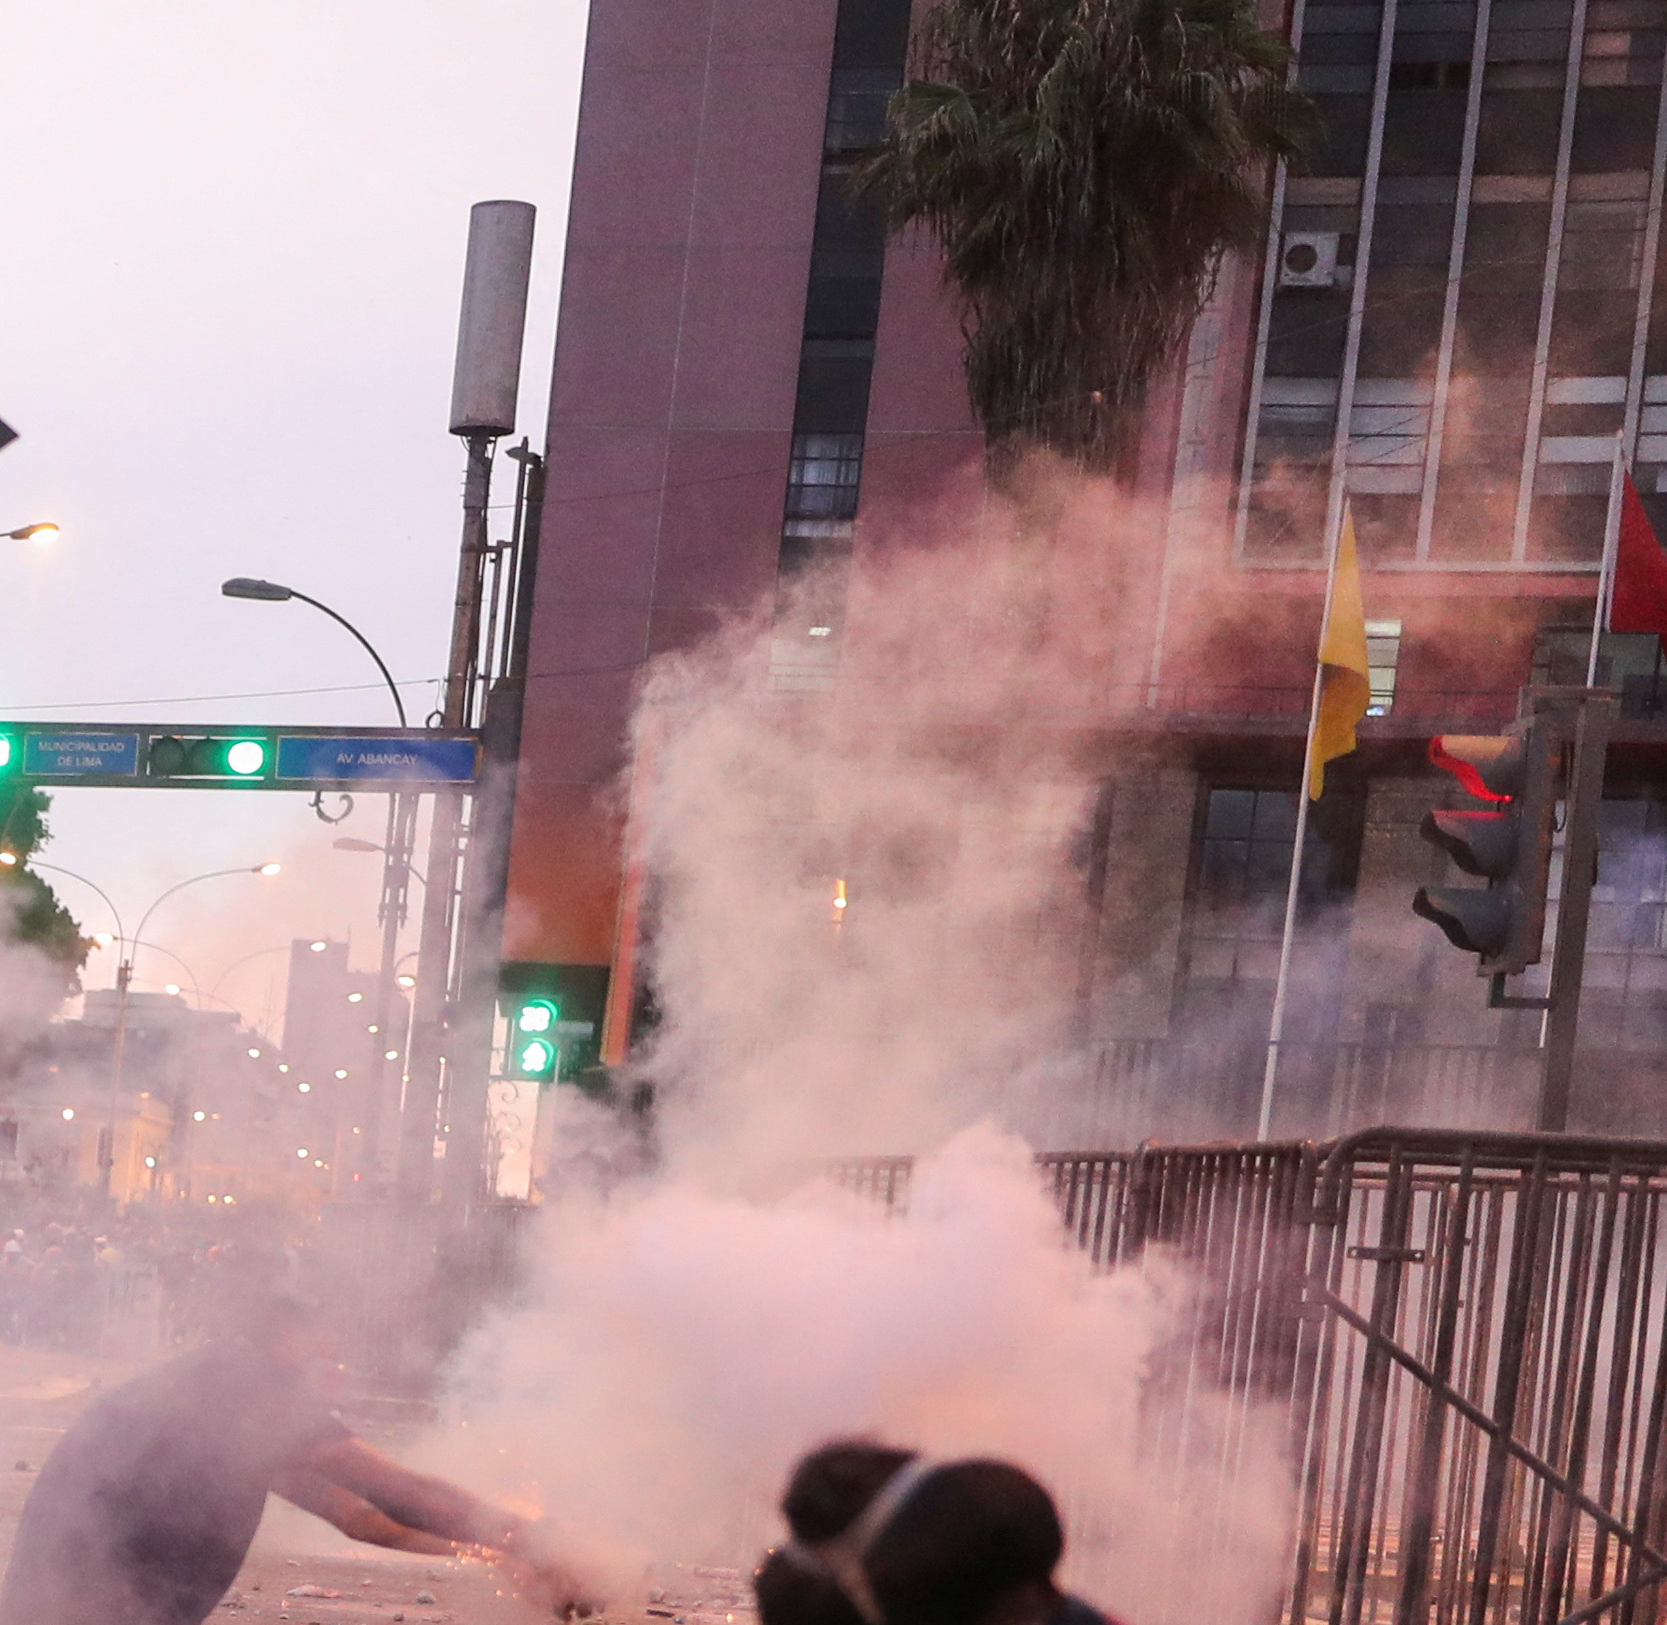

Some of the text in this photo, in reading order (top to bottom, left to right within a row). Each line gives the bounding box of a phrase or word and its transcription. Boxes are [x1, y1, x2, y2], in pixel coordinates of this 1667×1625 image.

[38, 741, 125, 753] MUNICIPALIDAD
[57, 756, 103, 767] DE LIMA
[356, 752, 419, 766] ABANCAY
